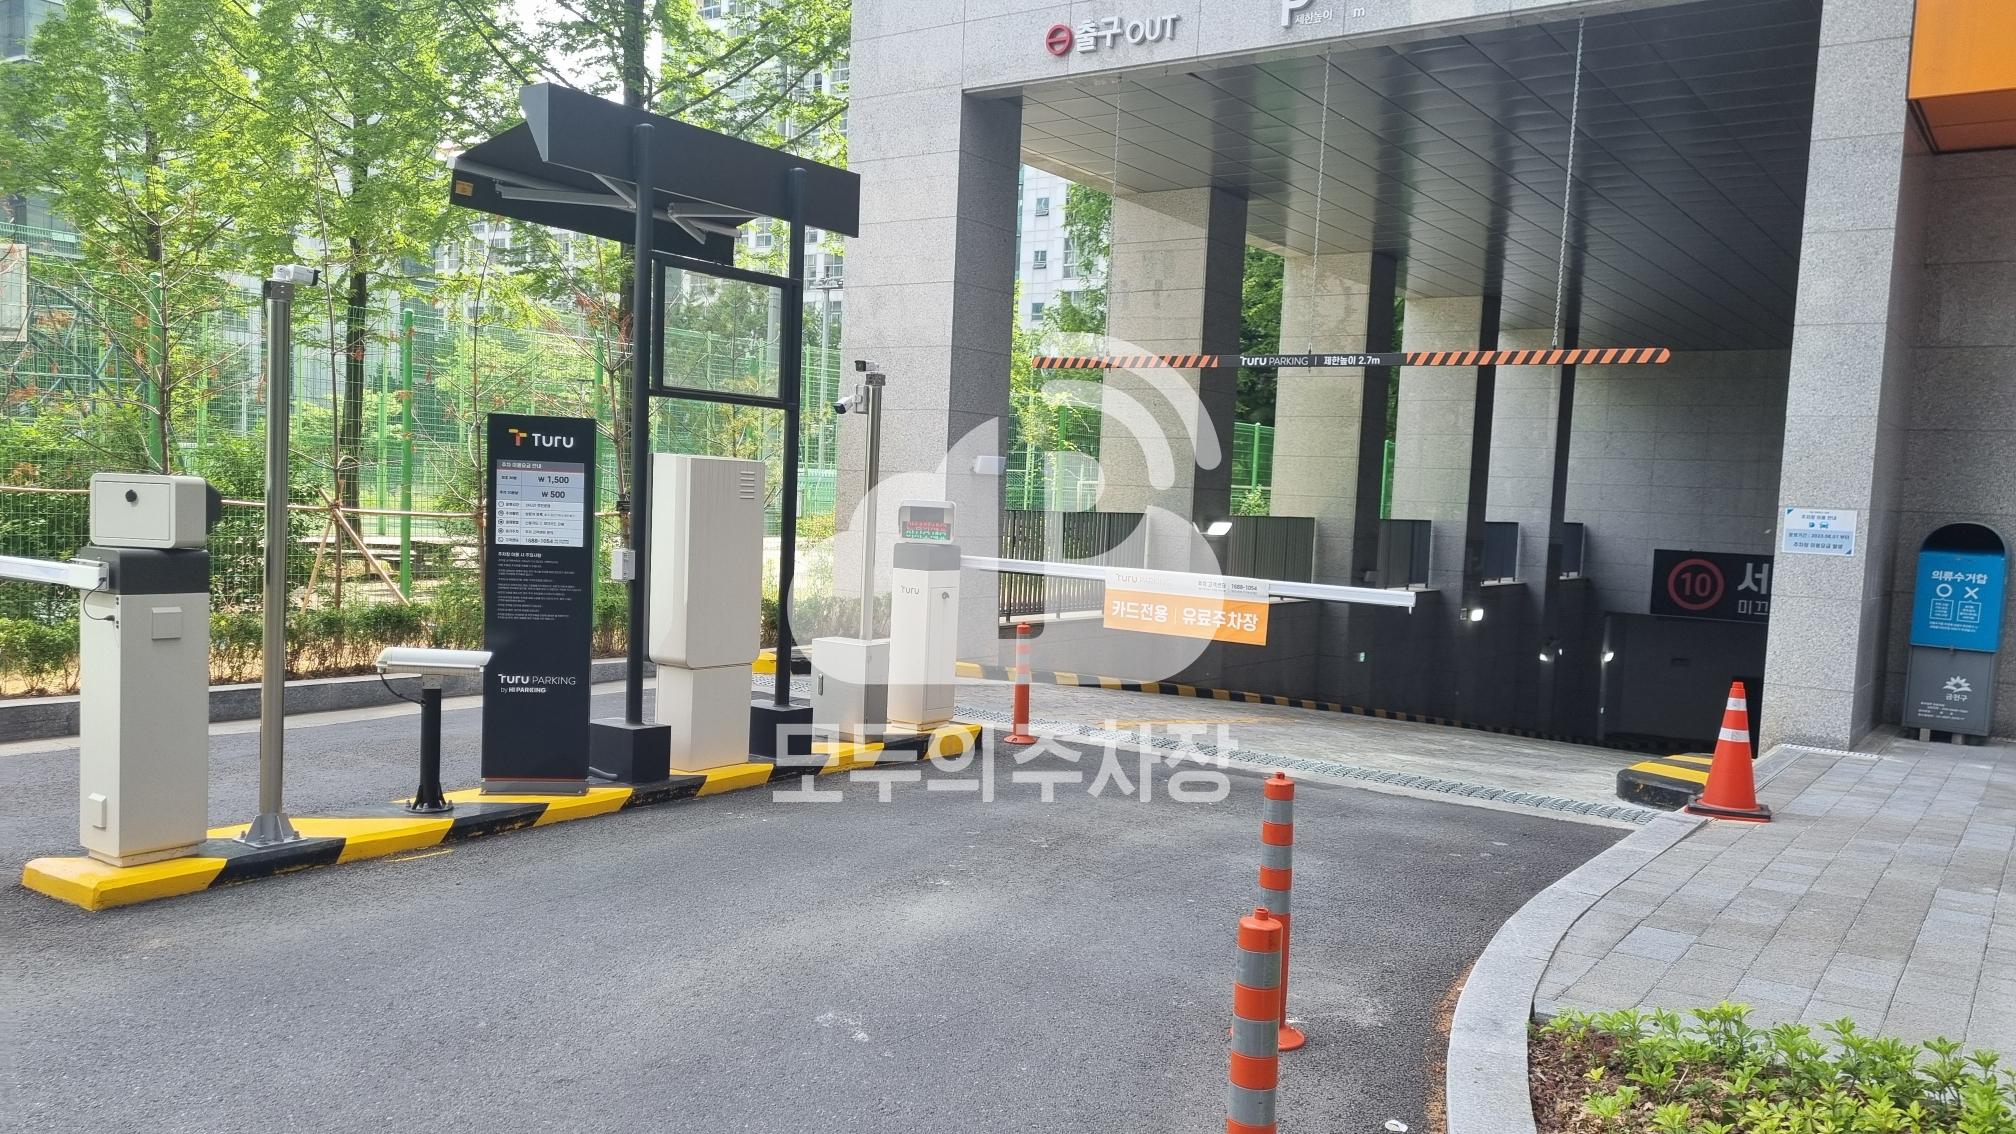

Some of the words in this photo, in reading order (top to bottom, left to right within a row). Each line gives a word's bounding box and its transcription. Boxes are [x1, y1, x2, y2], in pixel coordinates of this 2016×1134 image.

[1295, 9, 1333, 25] 제한높이
[1076, 16, 1122, 53] 출구
[1126, 14, 1181, 45] OUT
[1269, 356, 1309, 366] PARKING
[1324, 355, 1356, 366] 제한높이
[1359, 355, 1381, 365] 2.7m
[547, 475, 570, 485] 1,500
[550, 491, 566, 499] 500
[1931, 570, 1988, 585] 의류수거함
[1680, 572, 1712, 597] 10
[1112, 600, 1168, 623] 카드전용
[1182, 607, 1259, 632] 유료주차장
[533, 676, 577, 686] PARKING
[1946, 693, 1968, 702] 금천구
